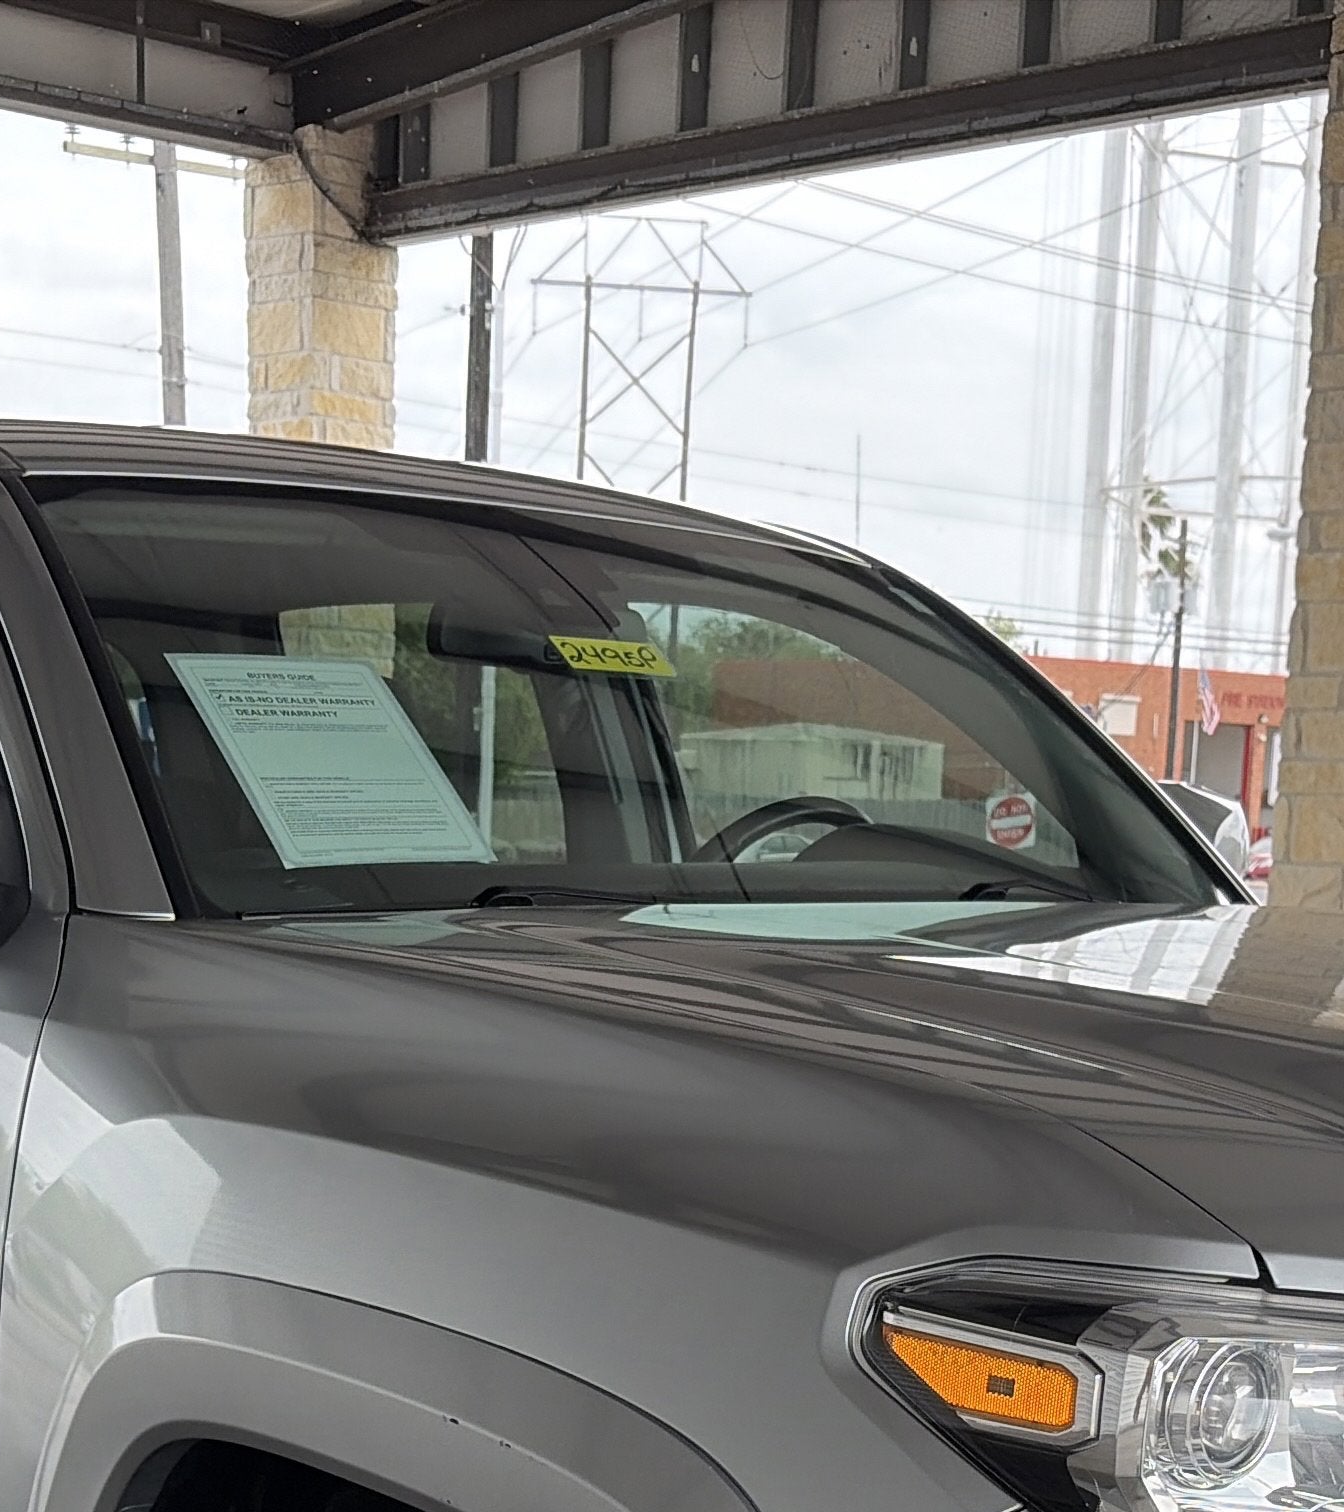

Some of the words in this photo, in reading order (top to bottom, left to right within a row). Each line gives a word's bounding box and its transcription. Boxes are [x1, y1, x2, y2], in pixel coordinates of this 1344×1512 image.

[559, 641, 658, 670] 2495P
[246, 671, 286, 680] BUYERS
[287, 673, 316, 681] GUIDE
[228, 695, 243, 703] AS
[275, 696, 318, 705] DEALER
[318, 698, 376, 707] WARRANTY
[235, 708, 278, 717] DEALER
[279, 709, 338, 718] WARRANTY
